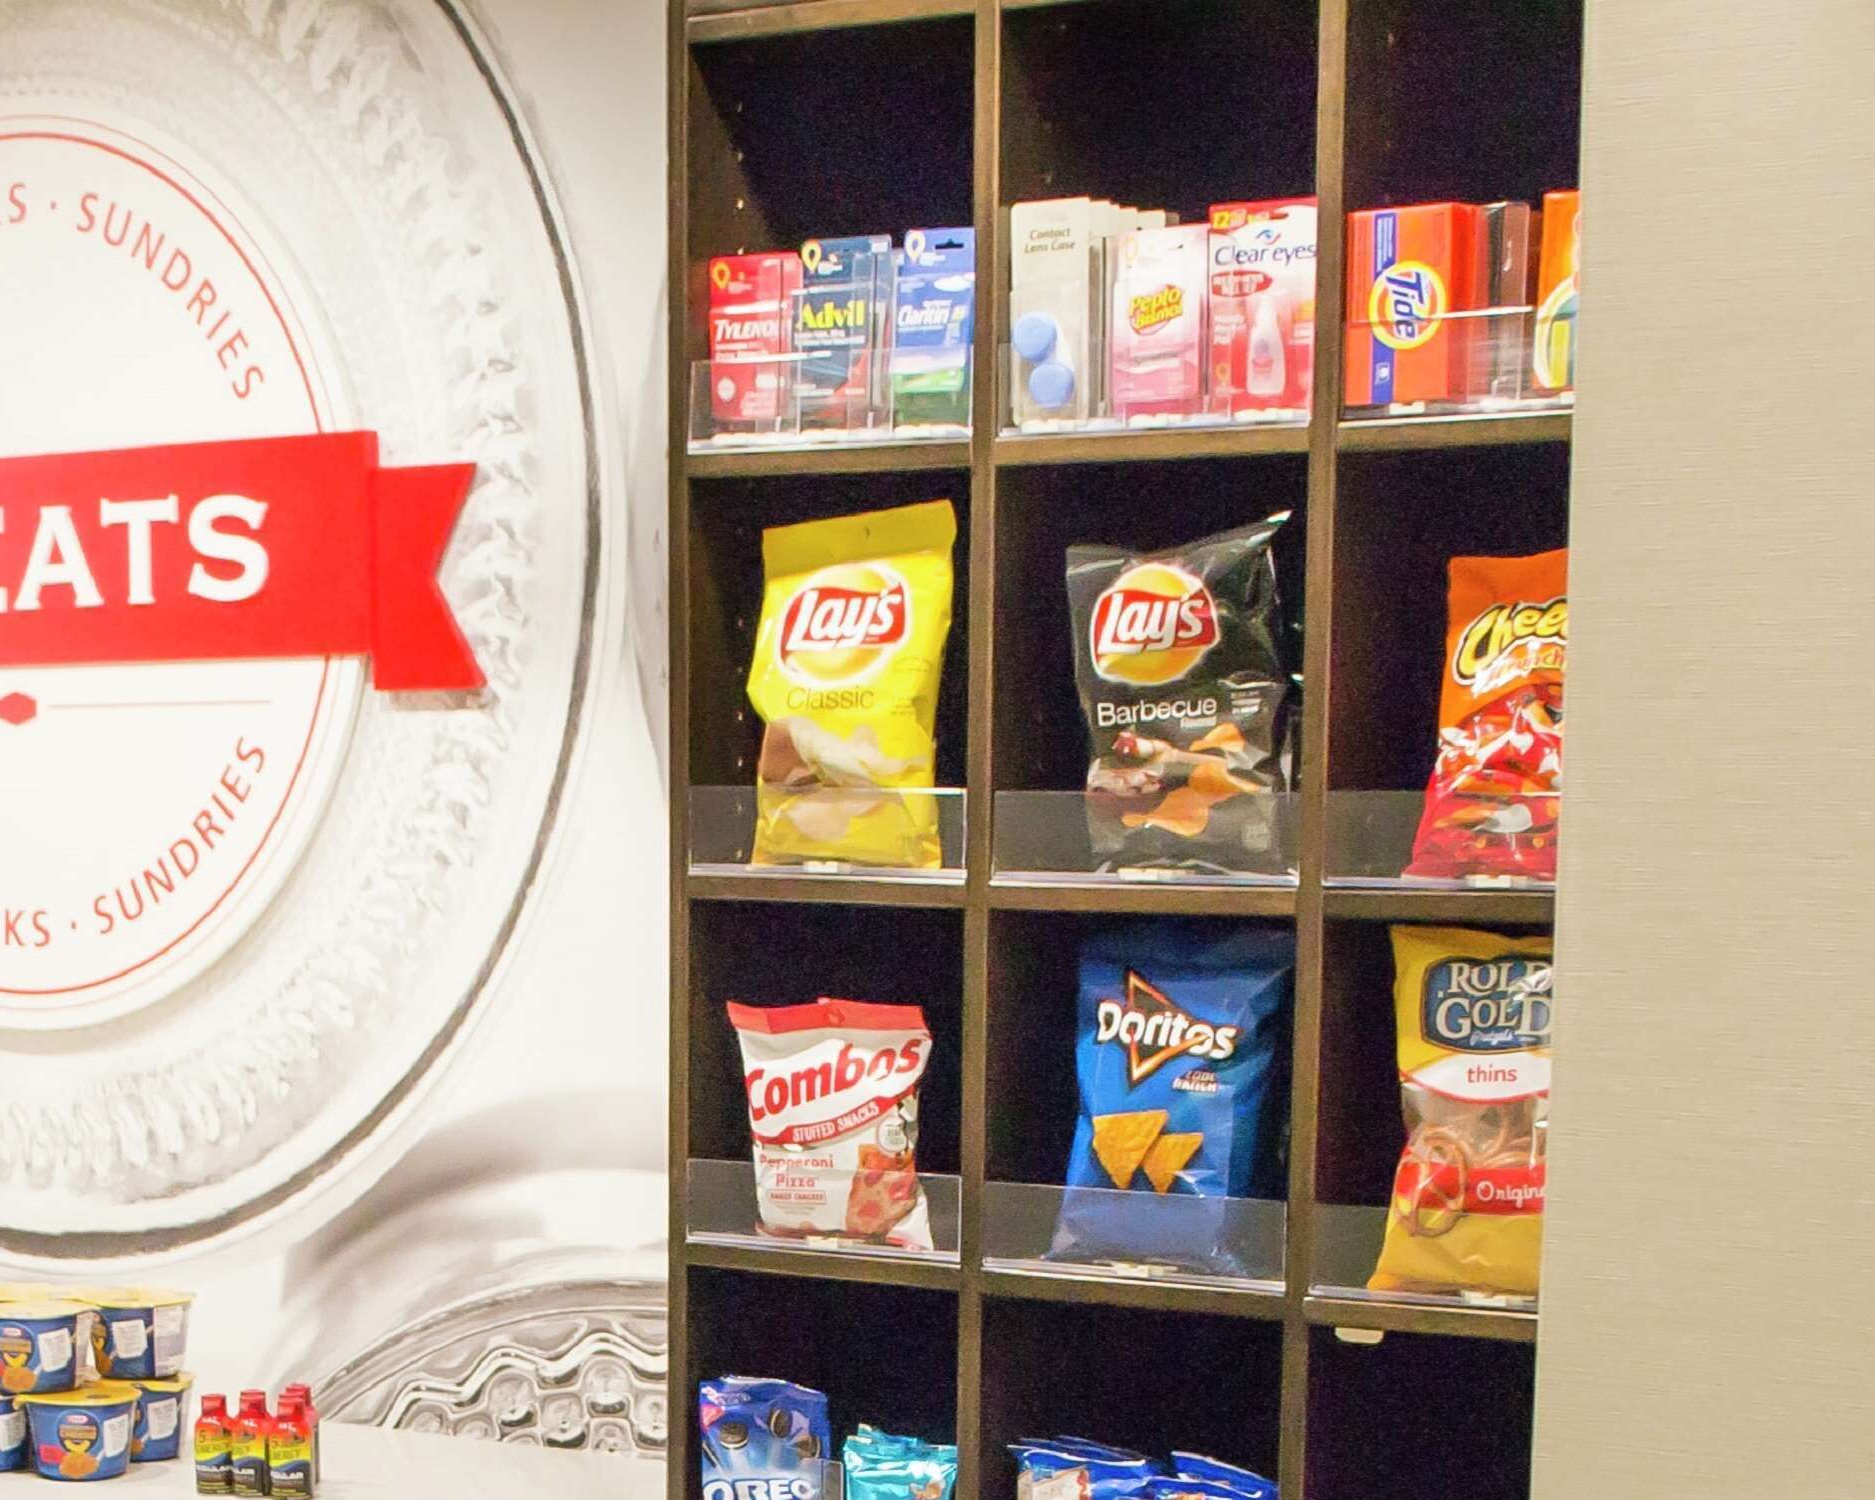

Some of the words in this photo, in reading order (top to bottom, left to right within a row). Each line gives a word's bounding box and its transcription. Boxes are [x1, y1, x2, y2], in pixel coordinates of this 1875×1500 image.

[1214, 245, 1267, 267] Clear
[1272, 243, 1317, 268] eyes
[75, 191, 268, 404] SUNDRIES
[800, 298, 867, 330] Advil
[1385, 270, 1425, 340] Tide
[785, 584, 903, 652] Lay's
[1096, 590, 1206, 657] Lay's
[1457, 598, 1568, 682] Chee
[785, 686, 876, 712] Classic
[1096, 697, 1218, 728] Barbecue
[91, 734, 271, 937] SUNDRIES
[1096, 999, 1239, 1061] Doritos
[1435, 995, 1551, 1039] GOLD
[743, 1037, 923, 1122] Combos
[1466, 1063, 1519, 1084] thins
[791, 1119, 836, 1144] STUFFED
[837, 1101, 880, 1133] SNACKS
